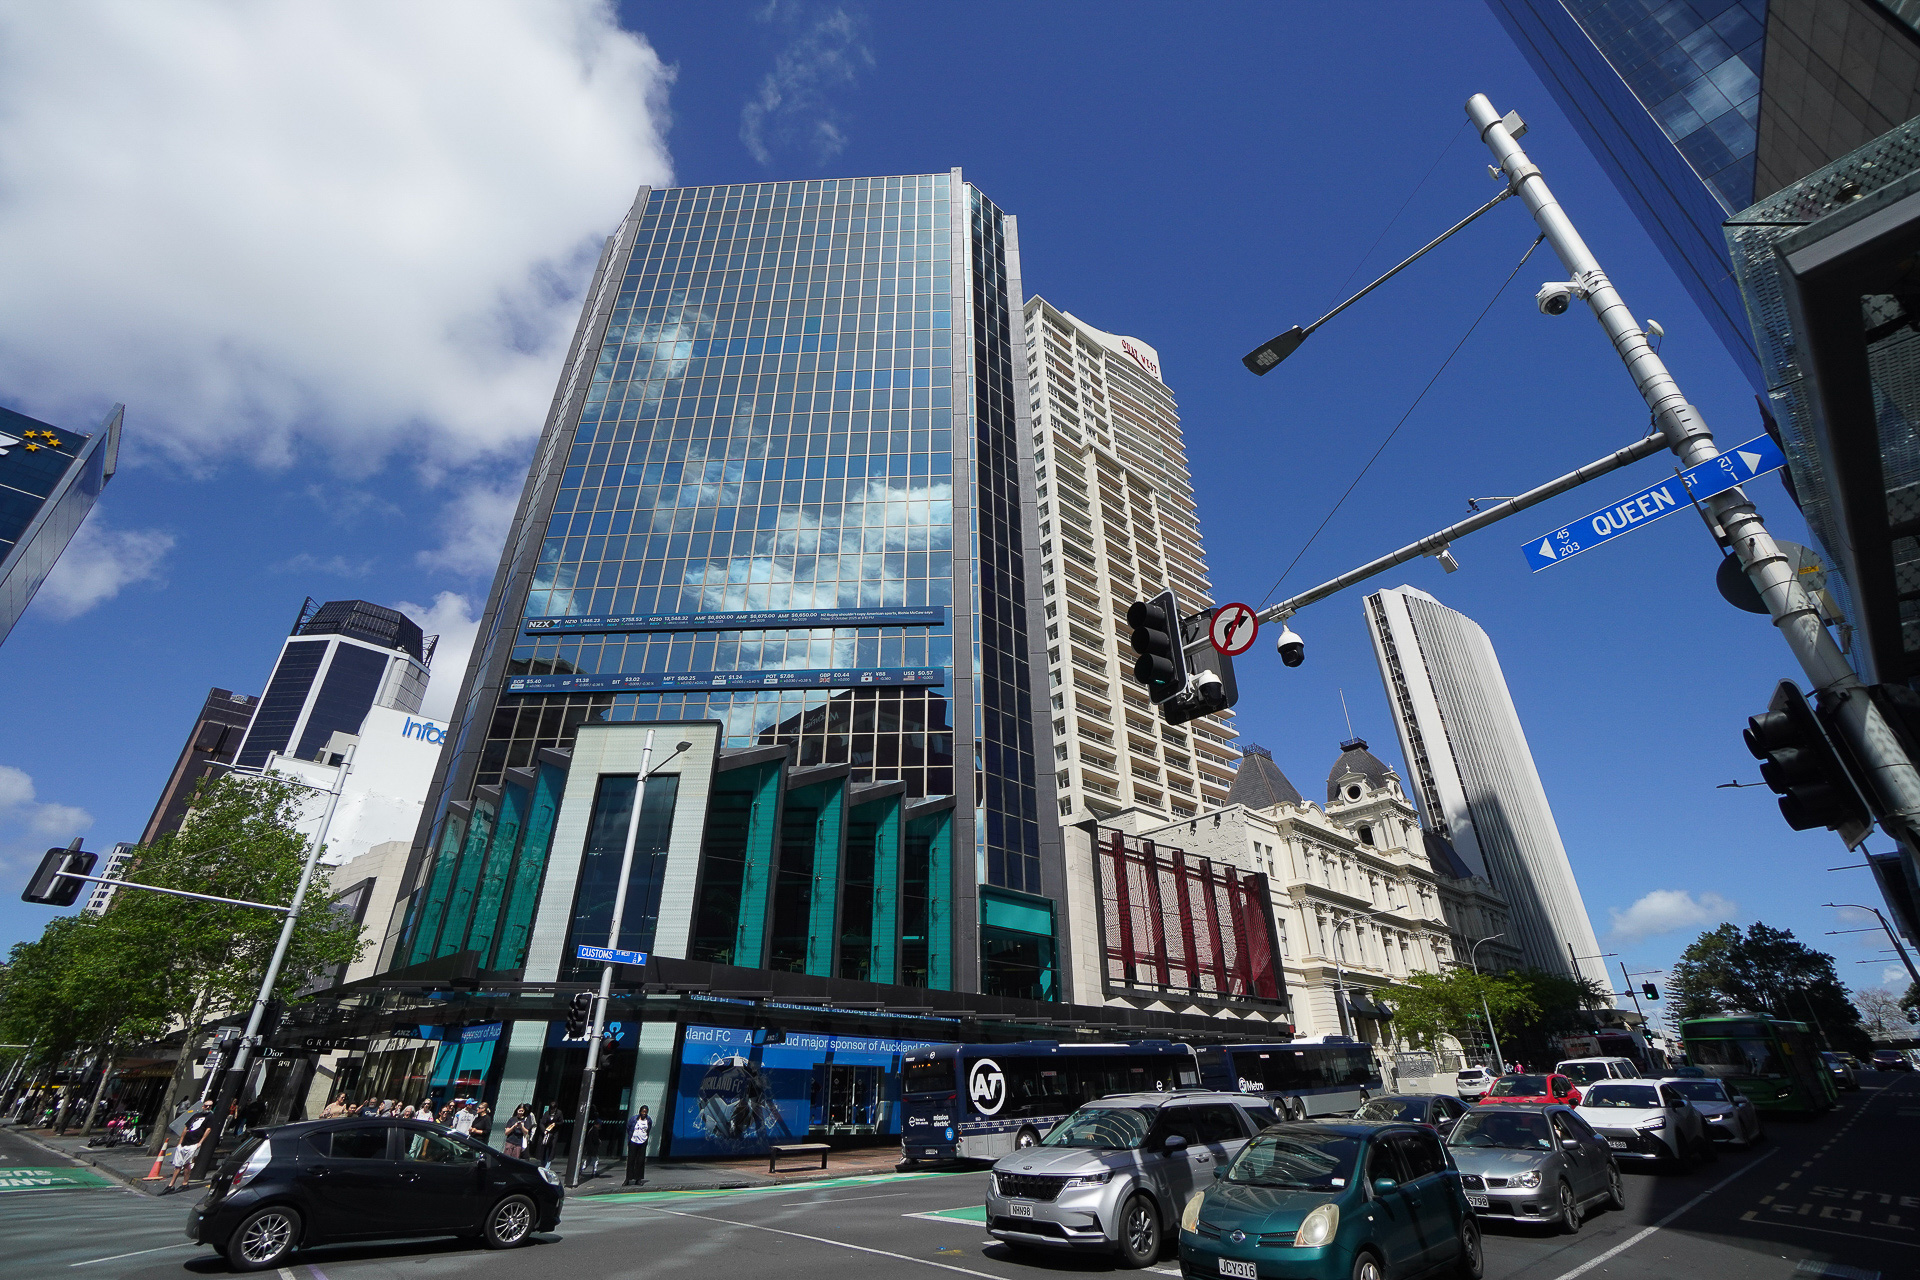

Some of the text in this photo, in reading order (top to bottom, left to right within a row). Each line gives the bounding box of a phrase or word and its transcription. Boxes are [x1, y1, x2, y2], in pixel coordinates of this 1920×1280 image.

[1140, 354, 1157, 374] WEST
[1717, 456, 1732, 470] 21
[1731, 472, 1738, 481] 1
[1591, 473, 1699, 536] QUEEN ST
[1556, 529, 1570, 541] 45
[1559, 541, 1581, 557] 203
[581, 947, 614, 960] CUSTOMS
[715, 1029, 731, 1042] FC
[306, 1038, 349, 1048] GRAFF
[801, 1037, 829, 1051] major
[830, 1039, 867, 1051] sponsor
[868, 1040, 879, 1051] of
[879, 1041, 918, 1053] Auckland
[263, 1047, 284, 1057] Dior
[731, 1078, 744, 1093] FC
[973, 1072, 1004, 1101] AT
[1246, 1080, 1264, 1091] Metro
[1012, 1205, 1031, 1216] NHN98
[1220, 1258, 1256, 1278] JCY316
